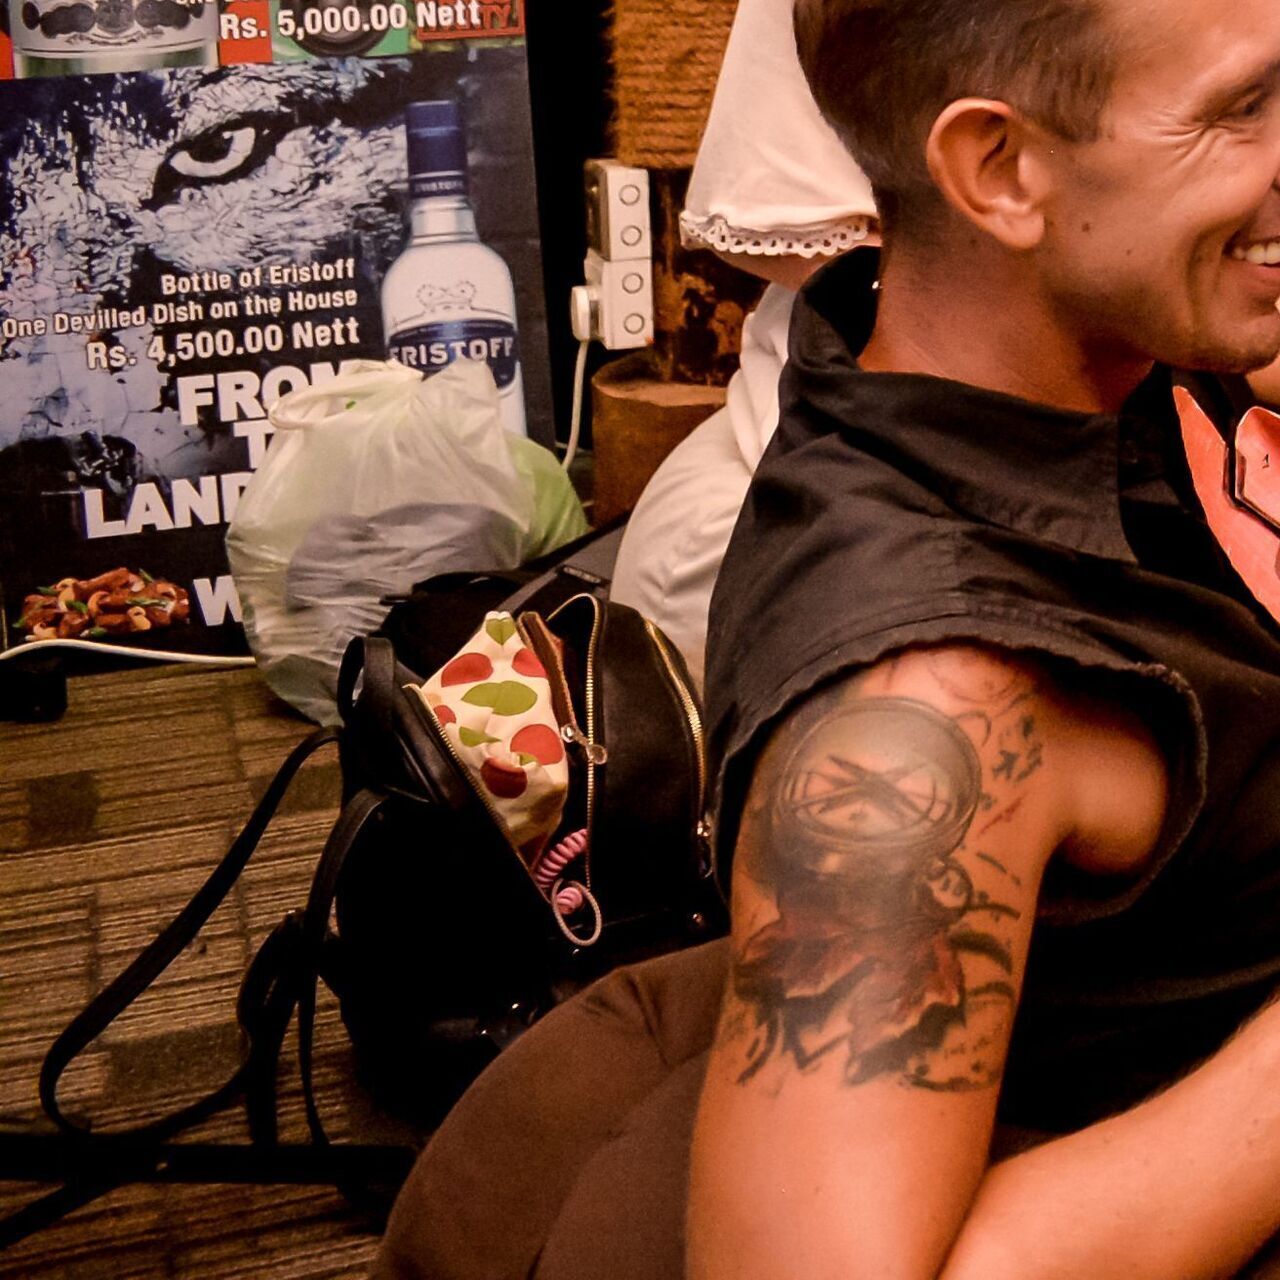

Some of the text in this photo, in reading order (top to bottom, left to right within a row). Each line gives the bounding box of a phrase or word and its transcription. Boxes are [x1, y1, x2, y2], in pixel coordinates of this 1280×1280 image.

[219, 13, 268, 40] Rs.
[277, 3, 407, 41] 5,000.00
[161, 258, 355, 295] Bottle of Eristoff
[2, 289, 358, 338] One Devilled Dish on the House
[86, 316, 360, 370] Rs. 4,500.00 Nett
